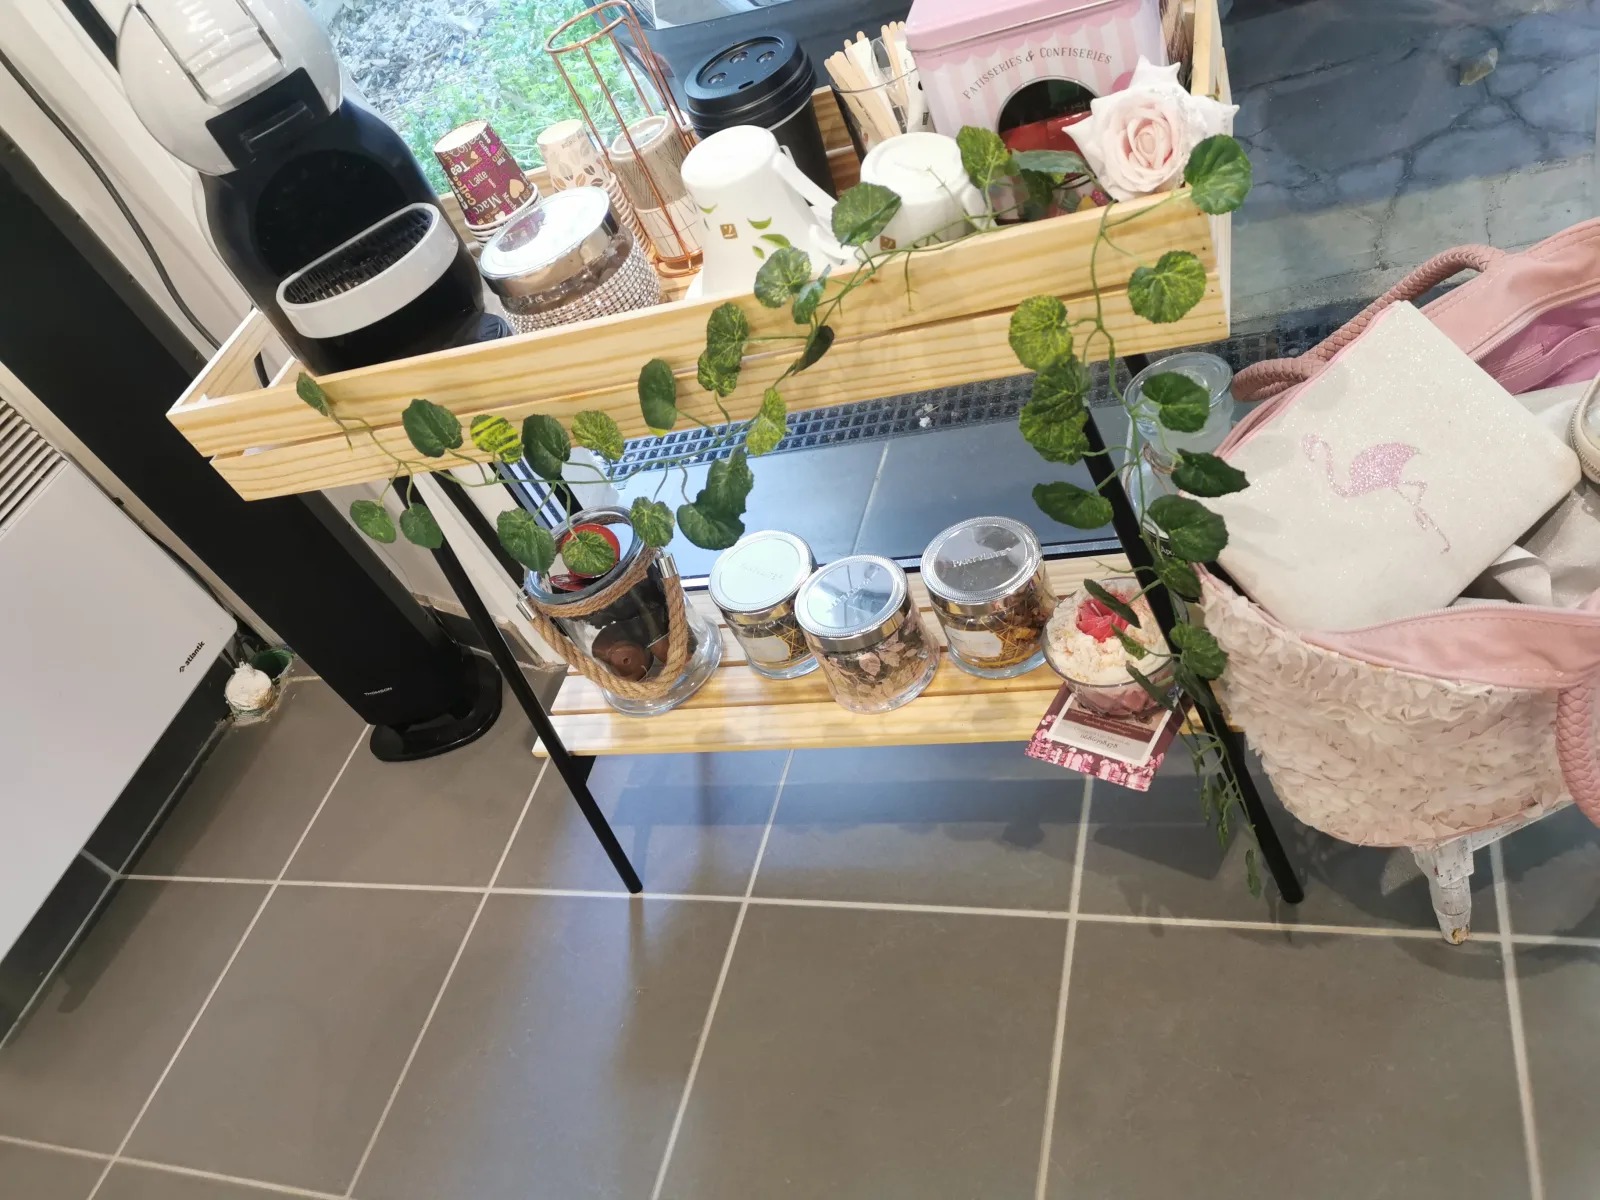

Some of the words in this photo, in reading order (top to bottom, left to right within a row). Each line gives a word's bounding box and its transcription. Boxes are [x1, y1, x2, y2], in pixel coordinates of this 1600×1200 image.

[962, 55, 1023, 99] PATISSERIES
[1025, 50, 1035, 62] &
[1039, 47, 1113, 65] CONFISERIES
[450, 161, 471, 175] Tea
[468, 171, 488, 187] Latte
[453, 176, 476, 205] Coffee
[185, 641, 205, 666] atlantic
